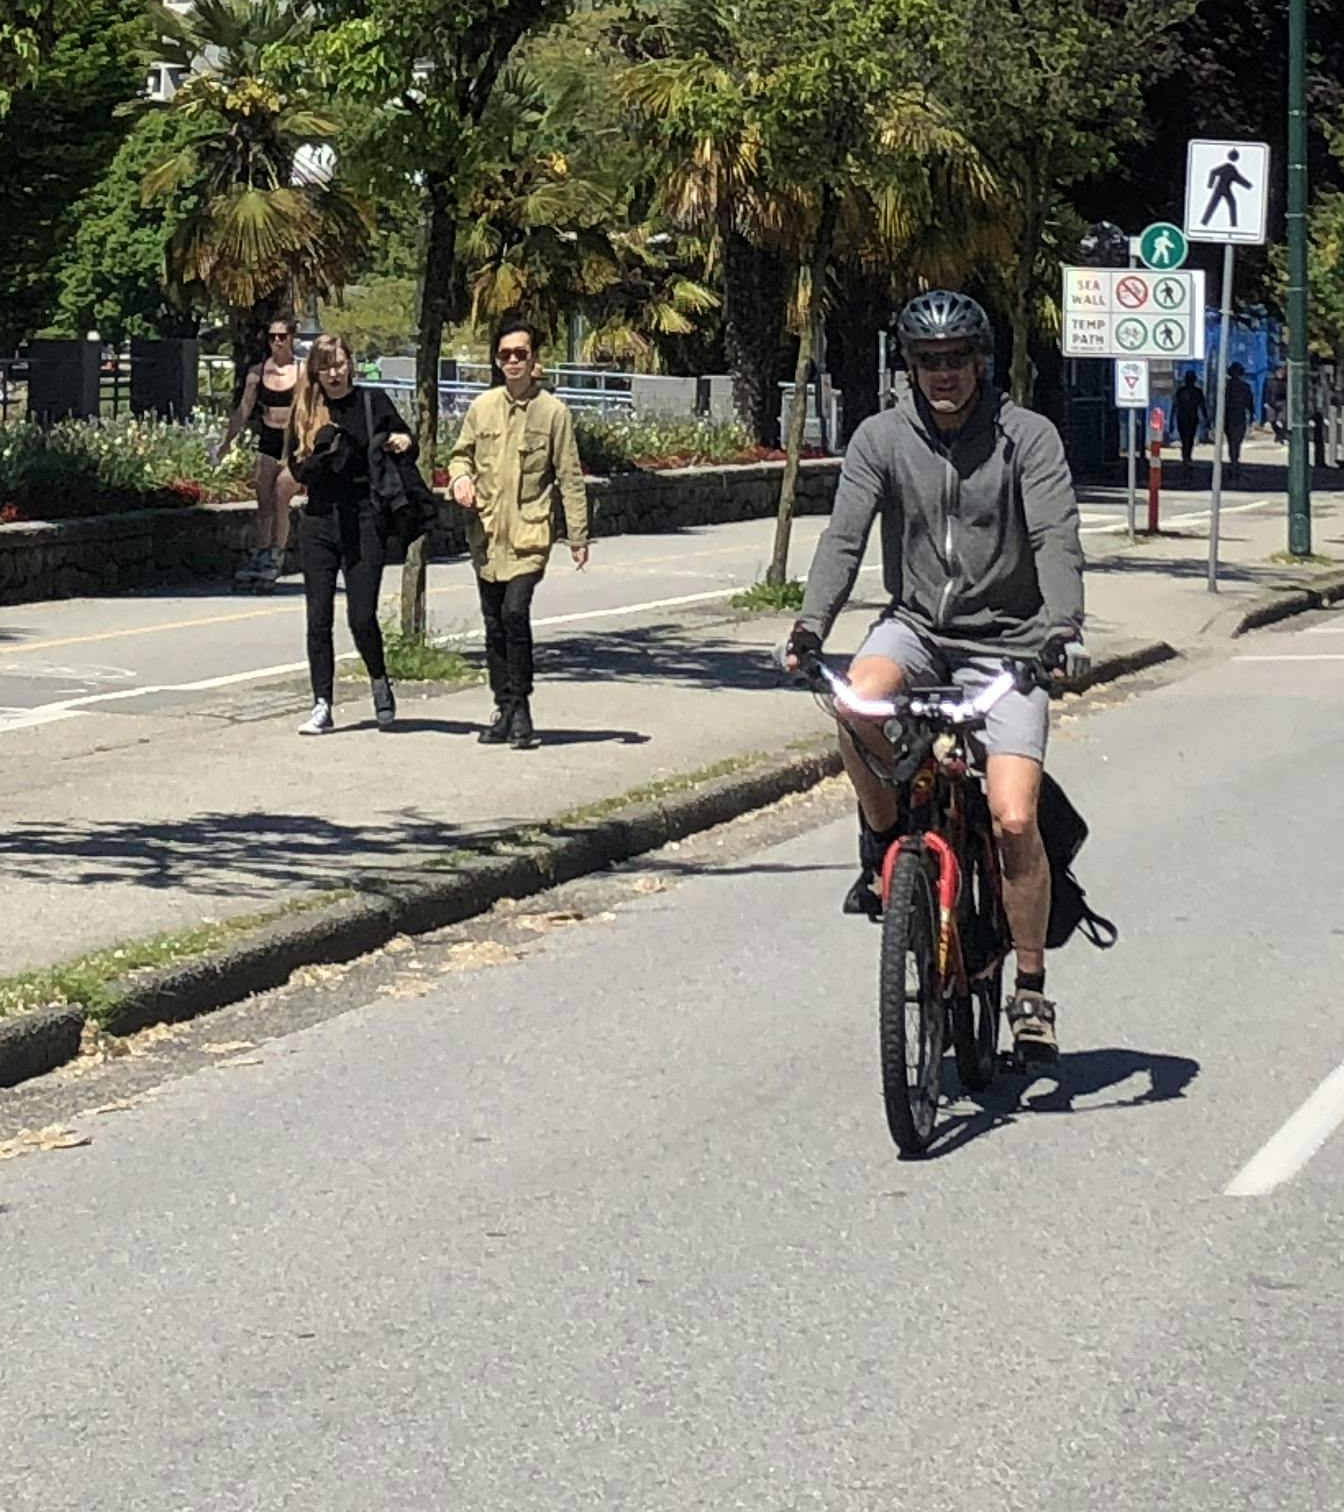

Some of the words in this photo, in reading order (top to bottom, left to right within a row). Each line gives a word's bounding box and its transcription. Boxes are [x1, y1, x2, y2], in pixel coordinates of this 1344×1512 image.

[1077, 279, 1101, 291] SEA
[1071, 295, 1105, 306] WALL
[1072, 319, 1105, 330] TEMP
[1072, 333, 1105, 345] PATH
